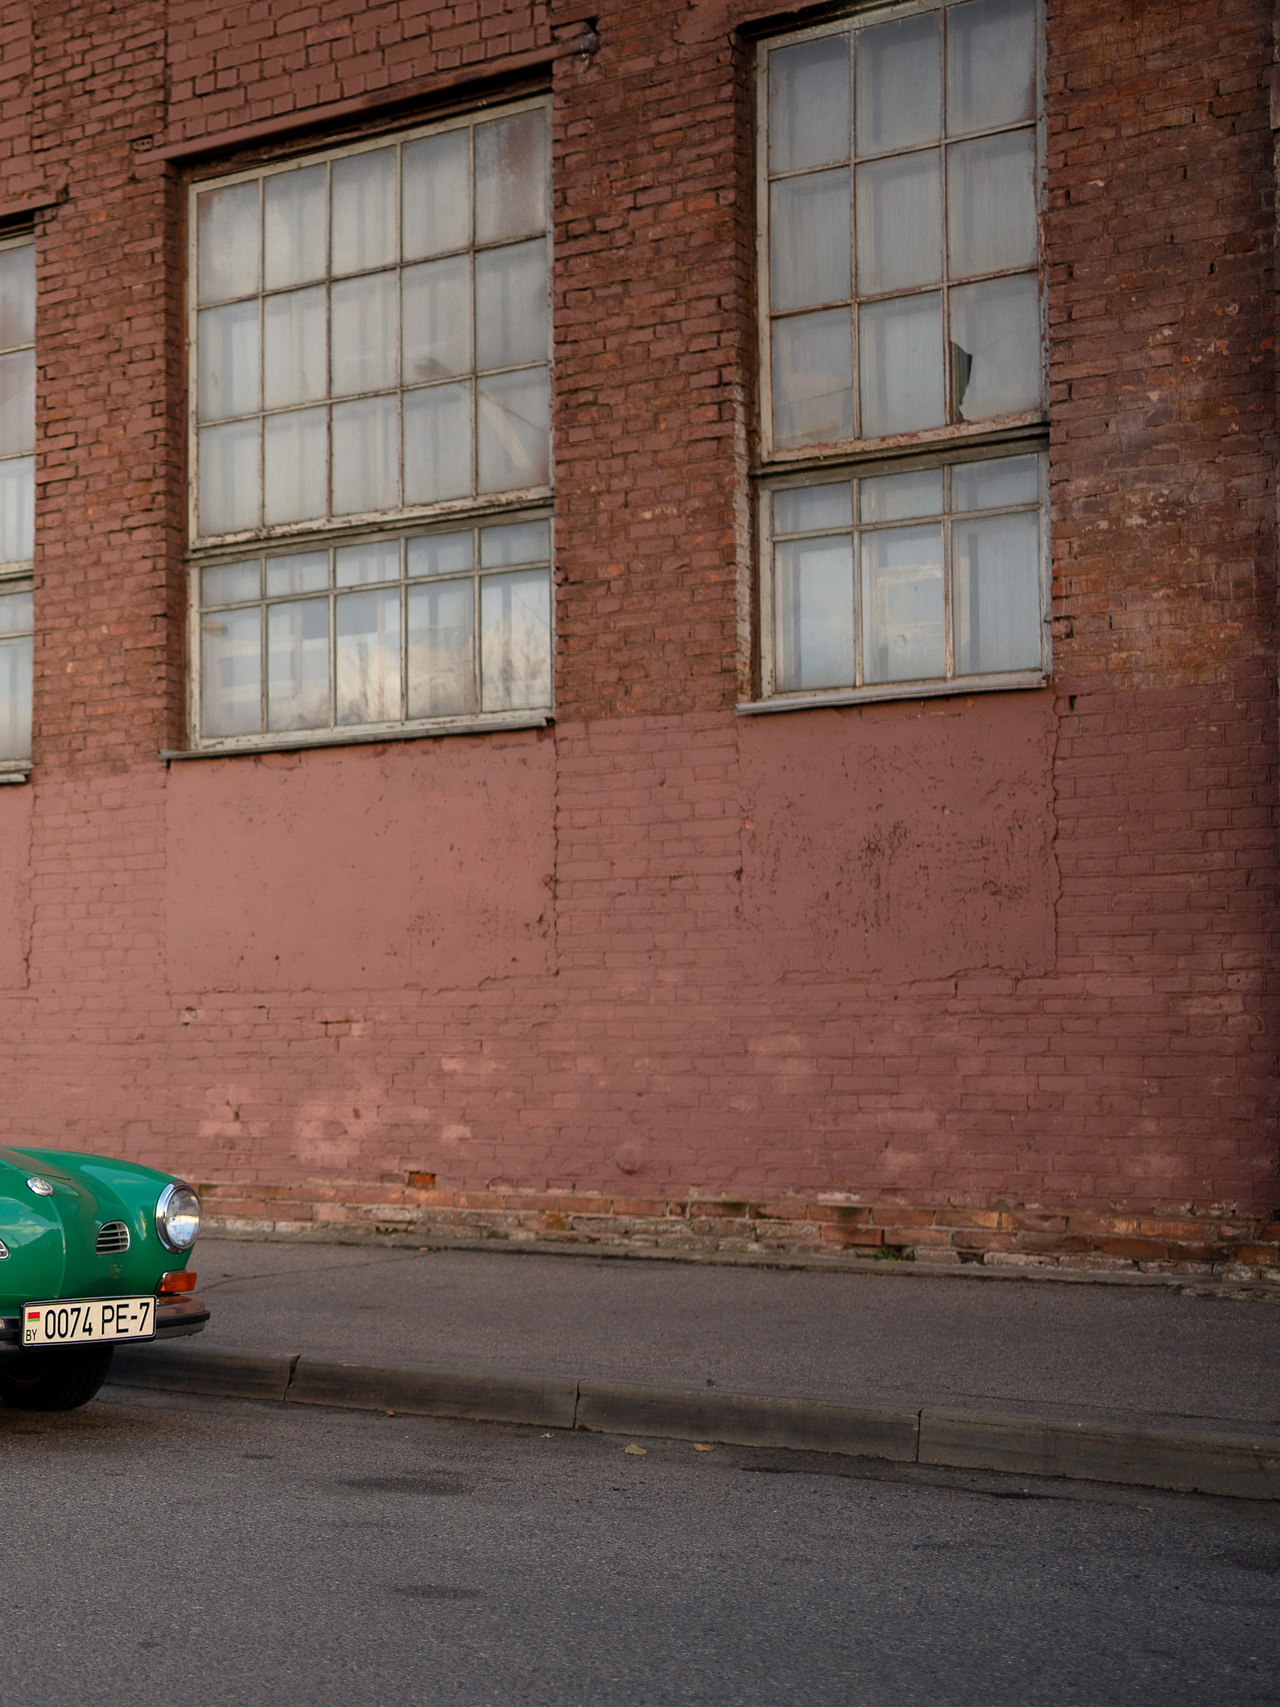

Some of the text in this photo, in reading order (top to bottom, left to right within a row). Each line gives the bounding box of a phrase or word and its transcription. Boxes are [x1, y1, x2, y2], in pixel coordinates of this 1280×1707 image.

[44, 1302, 150, 1339] 0074 PE-7
[26, 1328, 38, 1342] BY
